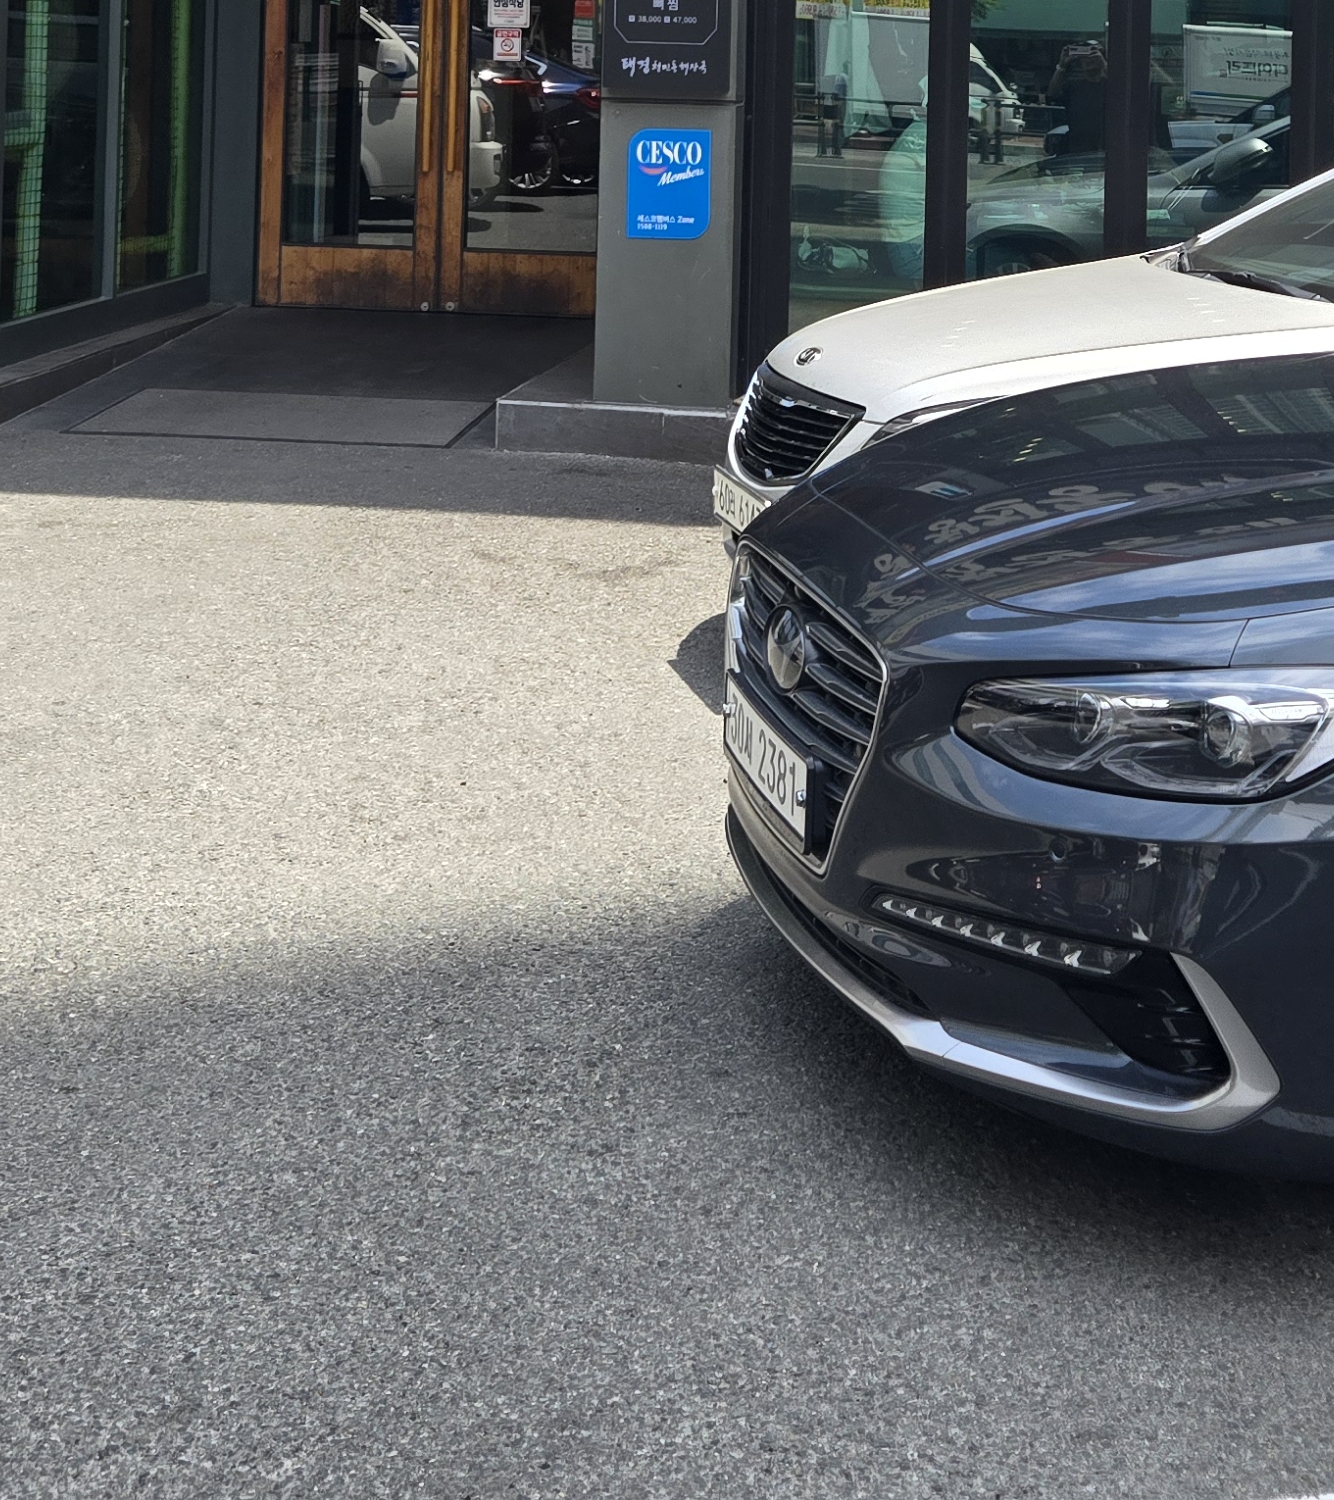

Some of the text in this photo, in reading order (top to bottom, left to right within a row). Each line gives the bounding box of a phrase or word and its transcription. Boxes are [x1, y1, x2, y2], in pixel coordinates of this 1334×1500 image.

[672, 16, 697, 24] 47,000
[636, 140, 702, 165] CESCO
[657, 166, 705, 187] Members
[758, 729, 795, 816] 2381
